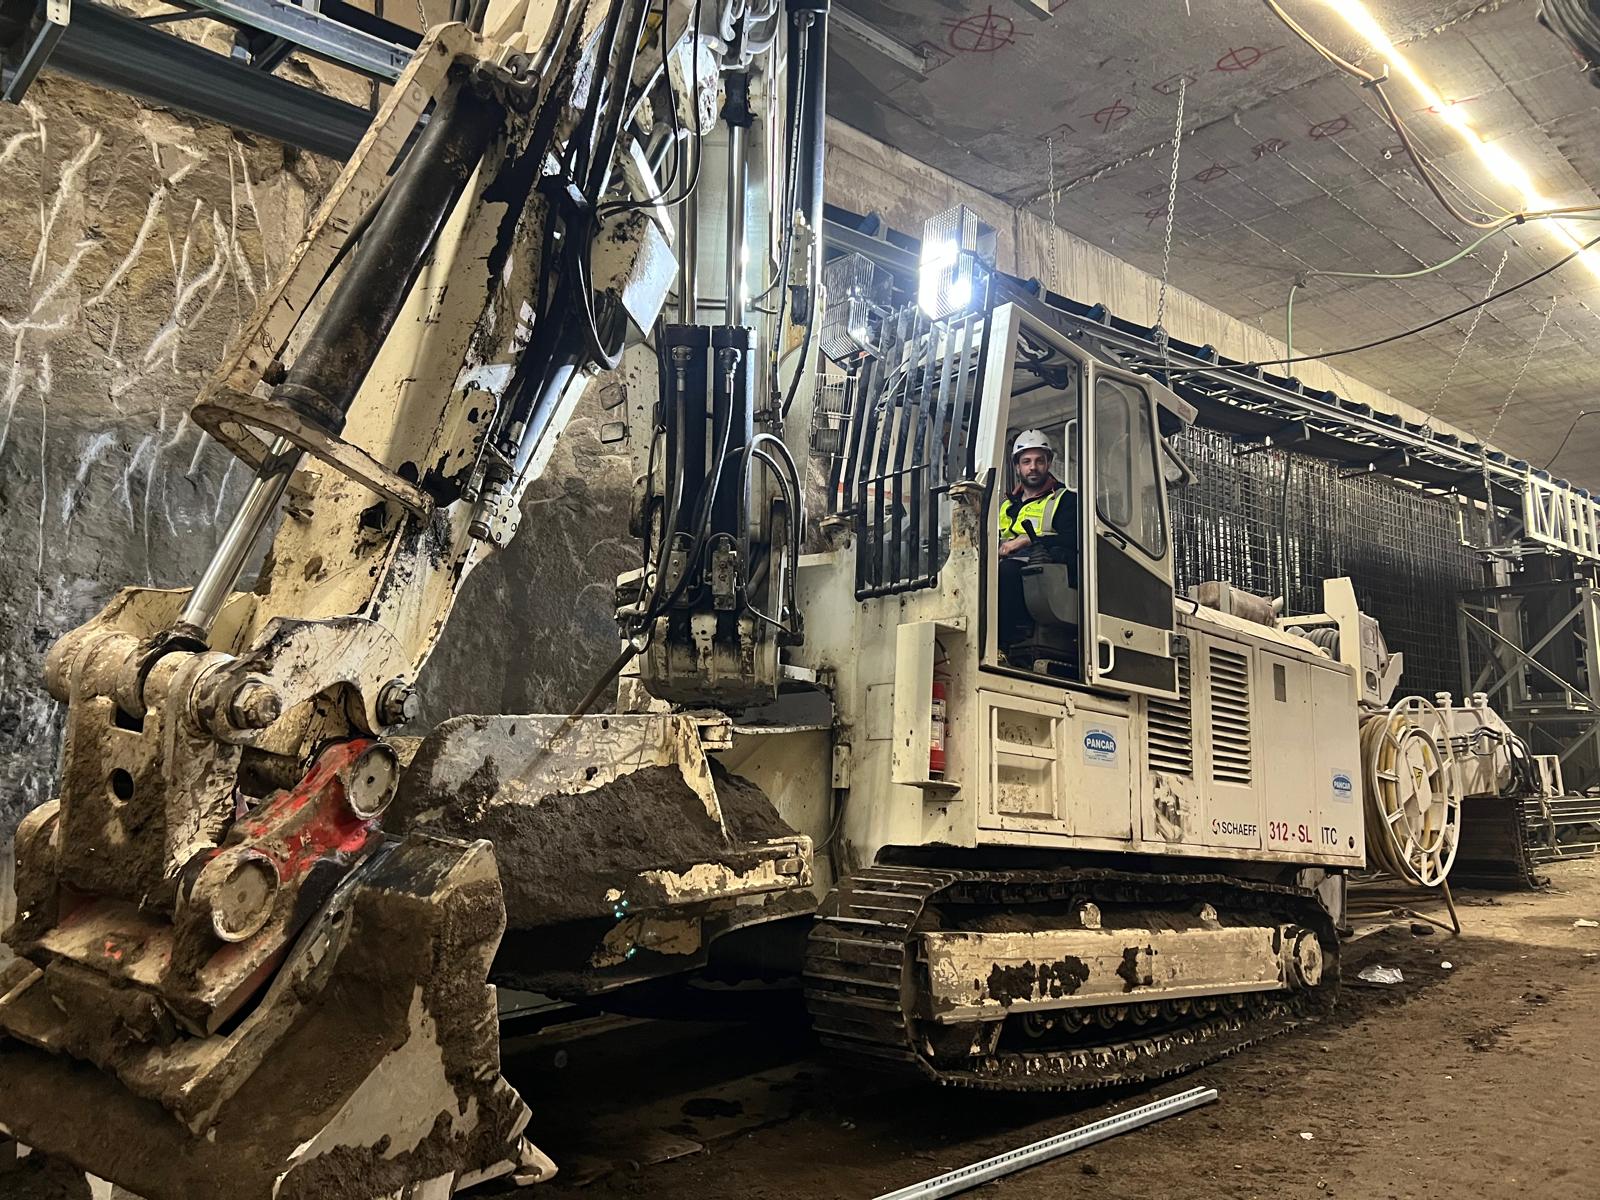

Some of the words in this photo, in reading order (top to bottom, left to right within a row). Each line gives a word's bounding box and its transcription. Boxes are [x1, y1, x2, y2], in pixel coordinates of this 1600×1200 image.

[1086, 738, 1115, 751] PANCAR
[1221, 821, 1257, 837] SCHAEFF
[1269, 822, 1289, 841] 312
[1321, 826, 1338, 845] ITC
